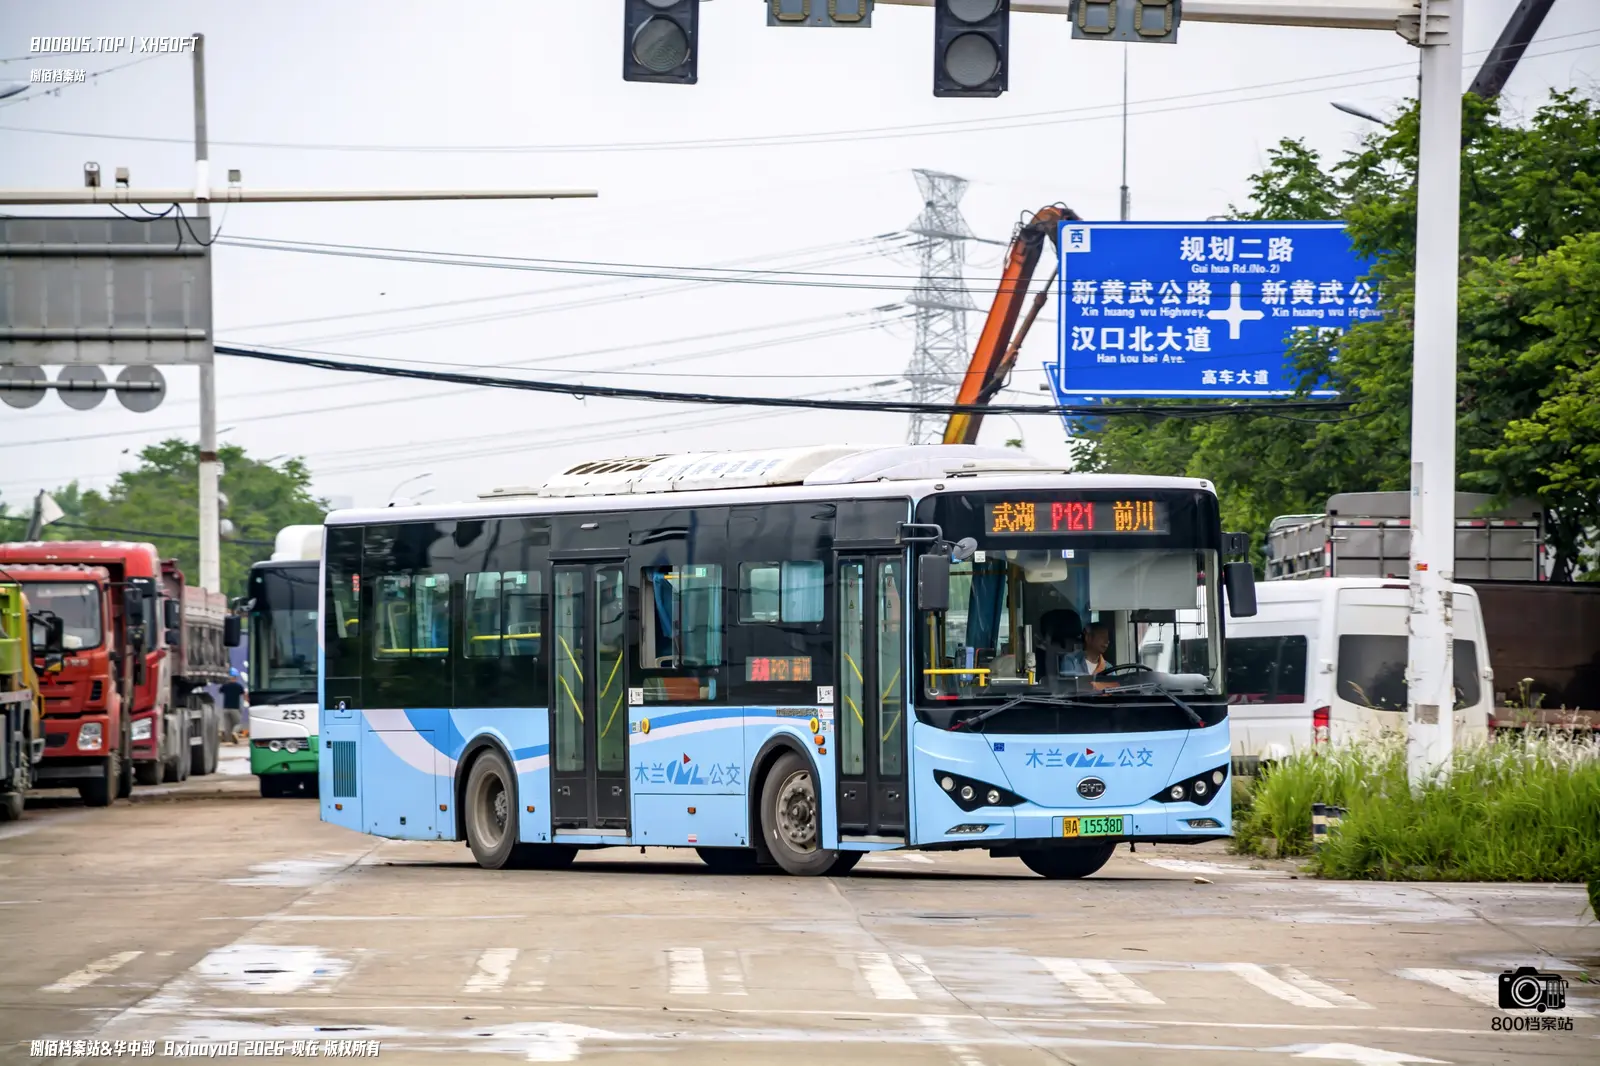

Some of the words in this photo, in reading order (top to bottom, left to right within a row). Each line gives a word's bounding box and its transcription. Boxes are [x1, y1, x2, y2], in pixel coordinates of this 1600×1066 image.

[1180, 236, 1294, 262] 规划二路
[1191, 263, 1208, 274] Gui
[1211, 263, 1230, 274] hua
[1071, 279, 1212, 305] 新黄武公路
[1261, 279, 1386, 305] 新黄武公
[1081, 306, 1099, 317] Xin
[1104, 306, 1135, 318] huang
[1140, 308, 1156, 317] wu
[1272, 307, 1290, 317] Xin
[1293, 307, 1325, 319] huang
[1328, 309, 1344, 317] wu
[1071, 325, 1212, 352] 汉口北大道
[1097, 354, 1117, 364] Han
[1120, 354, 1139, 364] kou
[1142, 354, 1158, 364] bei
[1162, 354, 1186, 364] Ave.
[1201, 369, 1269, 385] 高车大道
[991, 502, 1036, 532] 武湖
[1051, 502, 1094, 531] P121
[1111, 500, 1155, 531] 前川
[282, 709, 306, 720] 253
[1025, 748, 1063, 768] 木兰
[1118, 747, 1153, 767] 公交
[634, 761, 666, 784] 木兰
[709, 762, 742, 786] 公交
[1080, 782, 1104, 793] BYD
